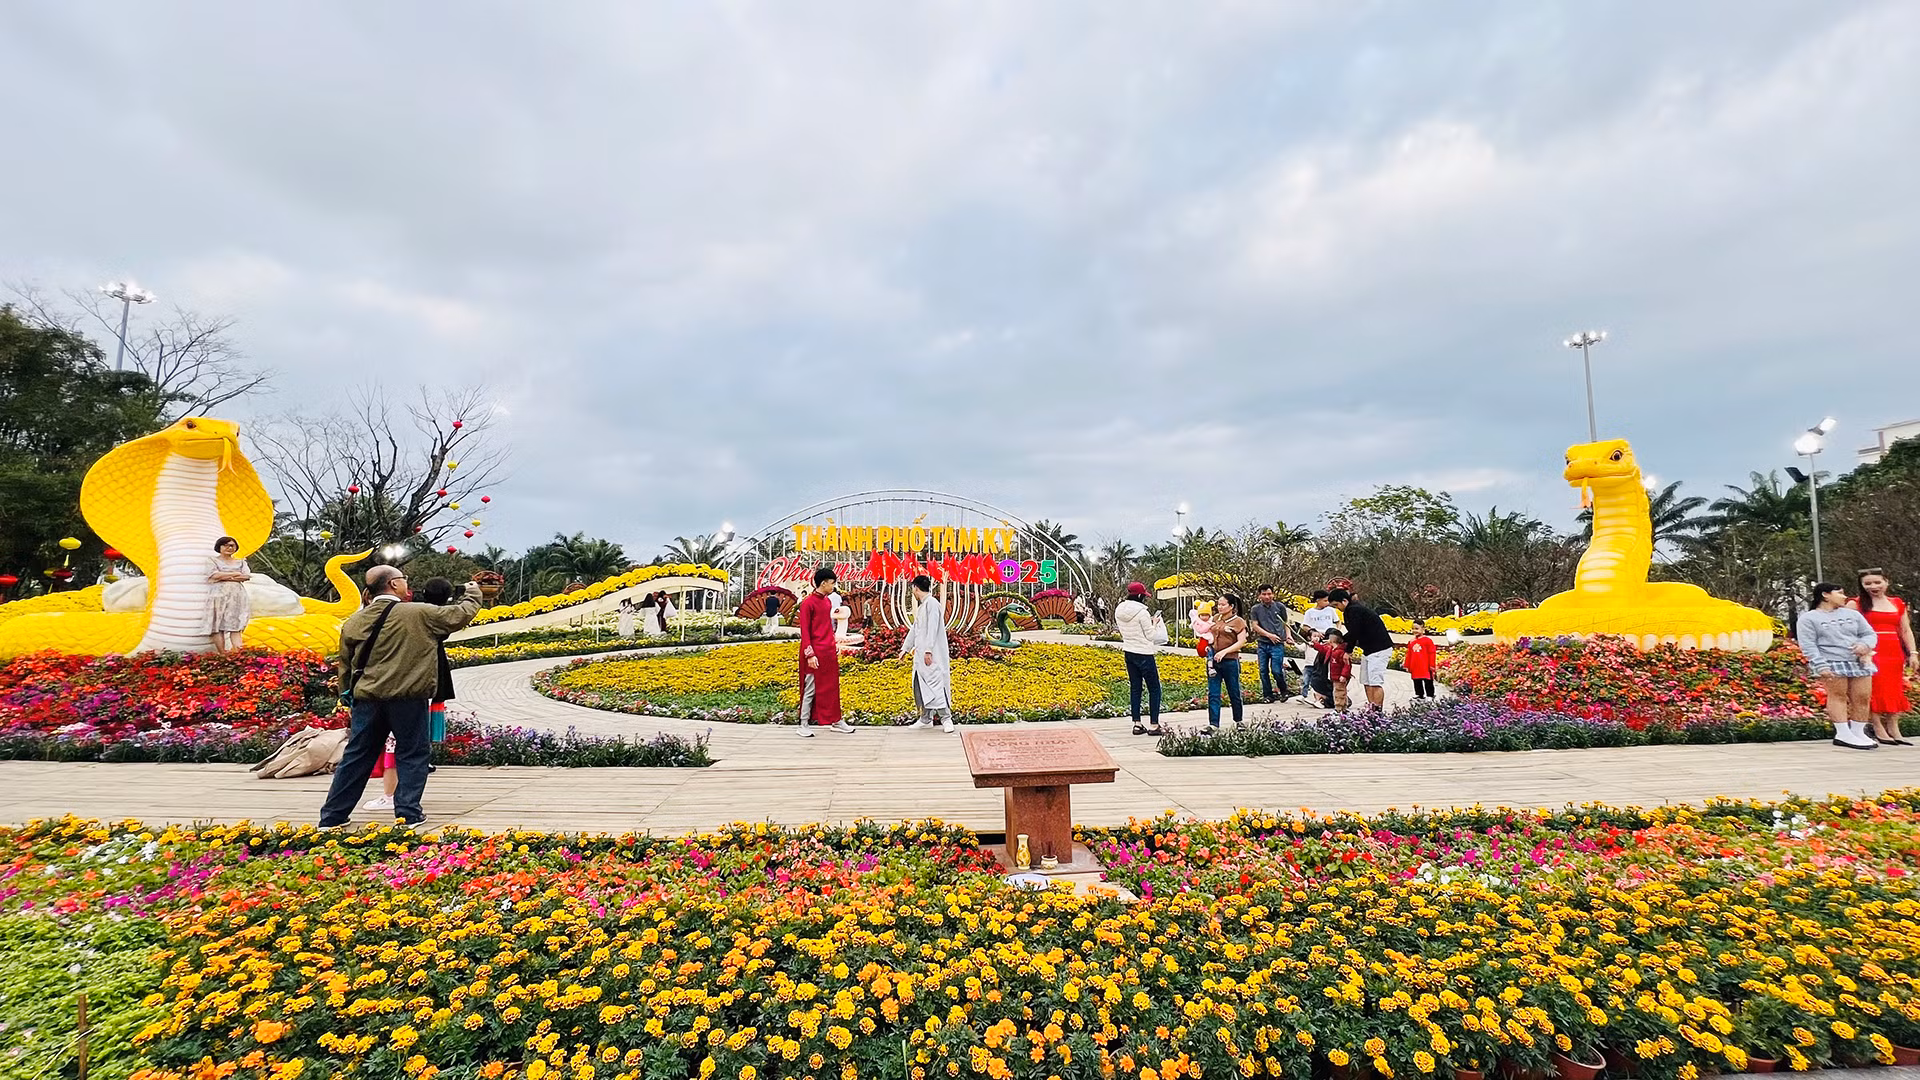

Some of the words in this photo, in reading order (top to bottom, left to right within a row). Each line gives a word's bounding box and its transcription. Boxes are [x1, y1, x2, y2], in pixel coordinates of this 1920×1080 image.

[792, 518, 872, 552] THÀNH
[878, 513, 928, 552] PHỐ
[931, 526, 978, 553] TAM
[983, 519, 1016, 554] KỲ
